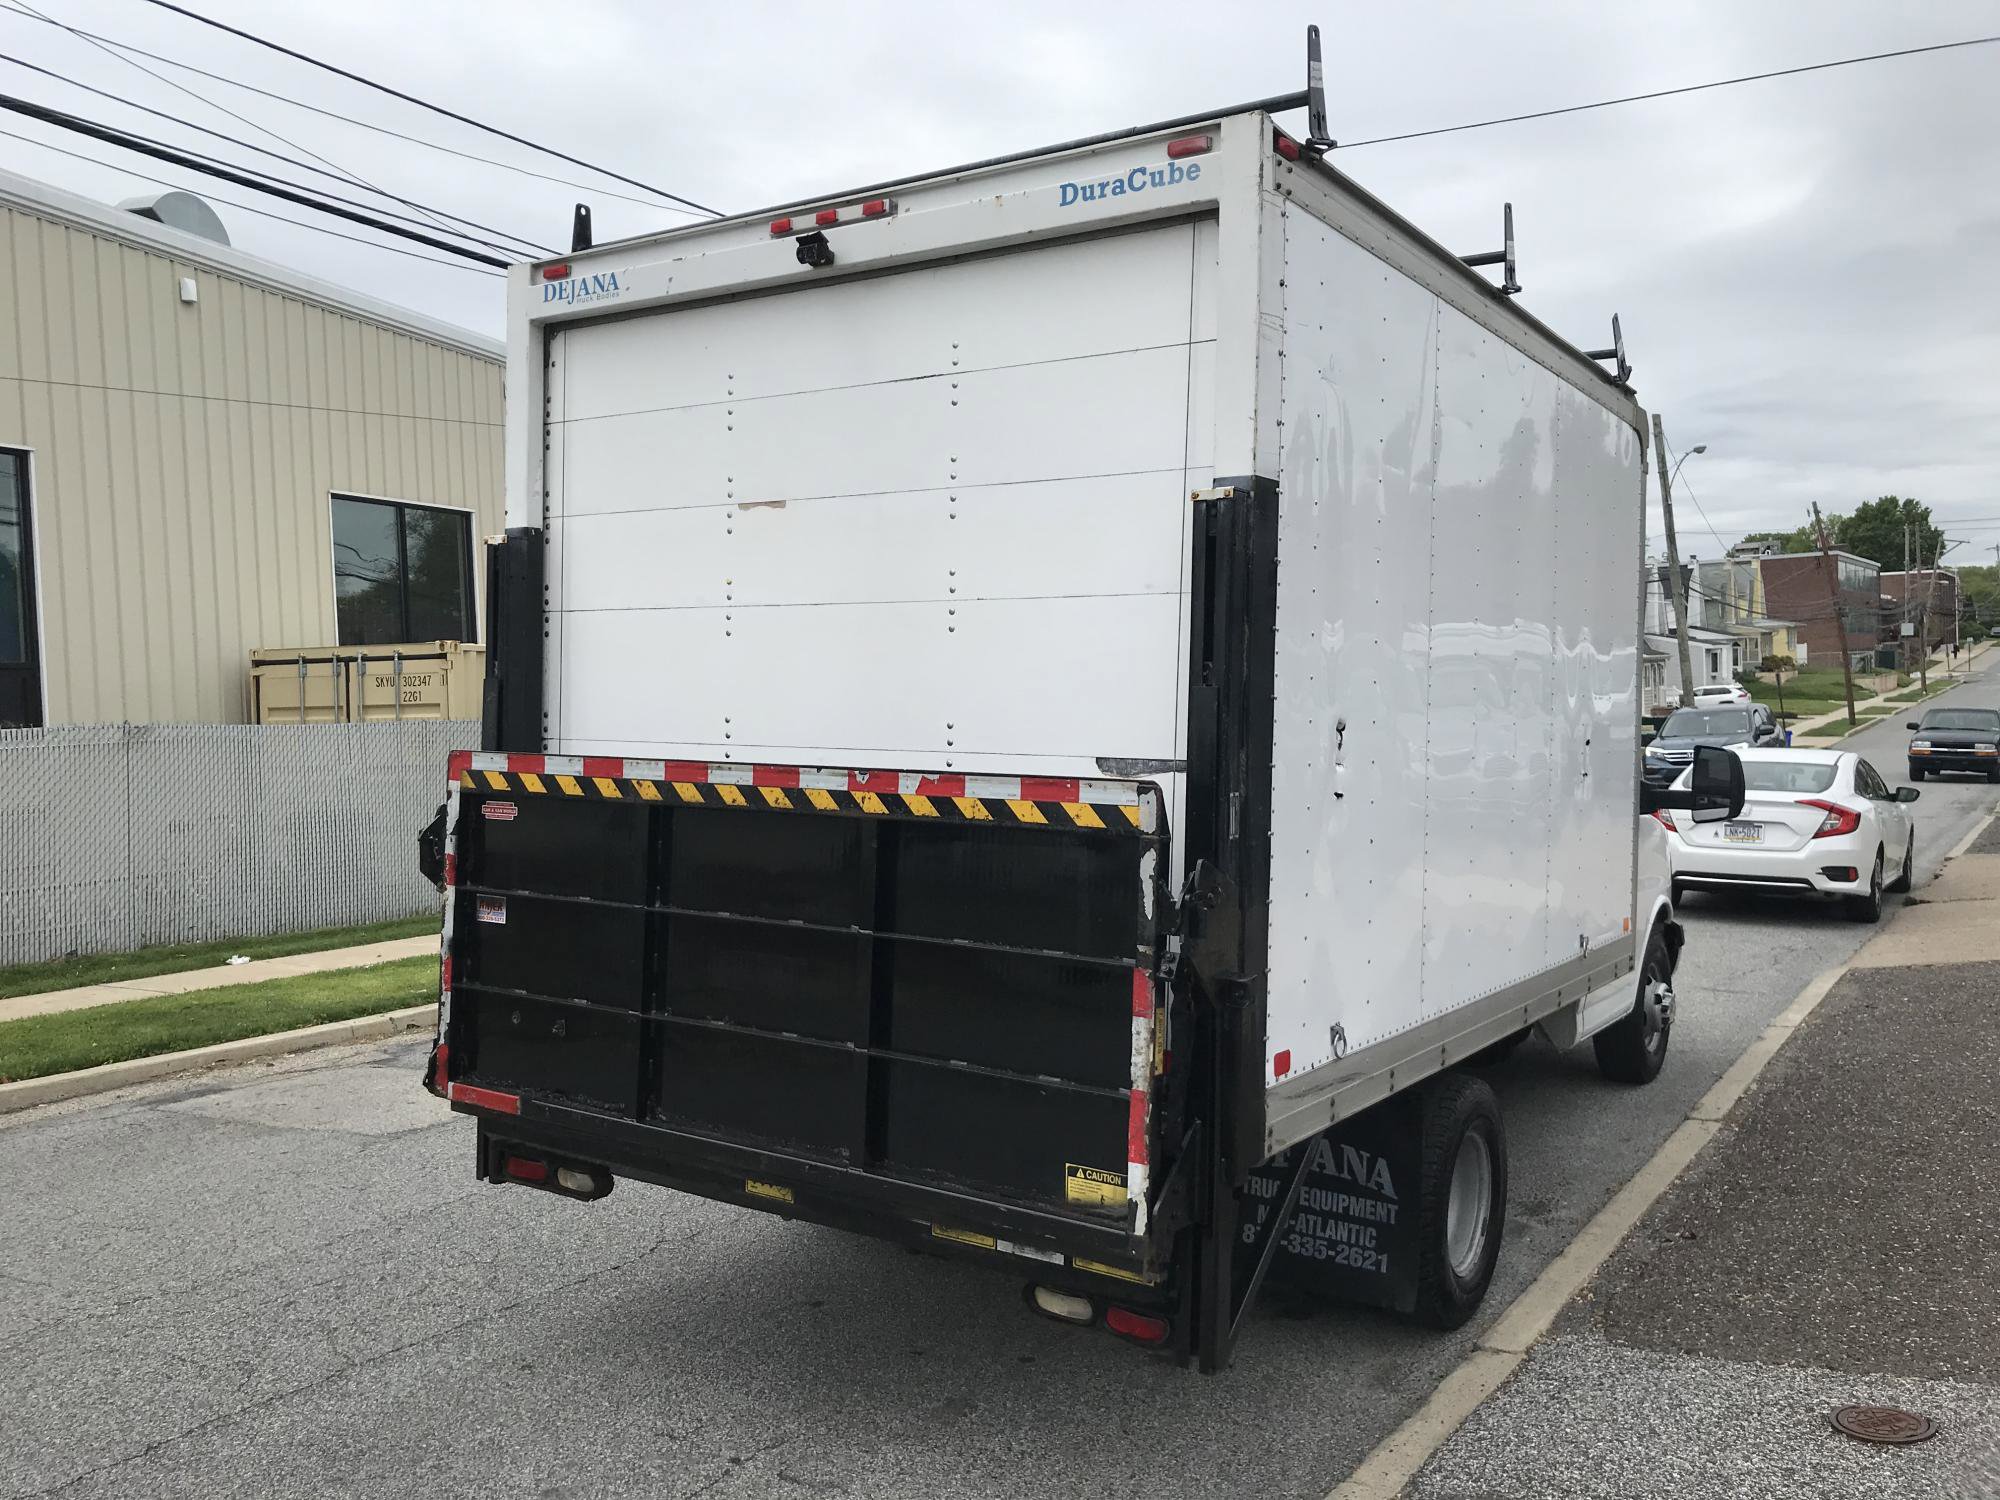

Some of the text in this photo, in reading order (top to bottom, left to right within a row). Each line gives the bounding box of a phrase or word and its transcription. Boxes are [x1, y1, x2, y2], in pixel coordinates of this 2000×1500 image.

[1059, 162, 1201, 207] DuraCube
[543, 271, 619, 305] DEJANA
[375, 676, 395, 687] SKYU
[403, 675, 432, 687] 302347
[403, 691, 422, 702] 22G1
[1085, 1170, 1122, 1185] CAUTION
[1299, 1185, 1399, 1225] EQUIPMENT
